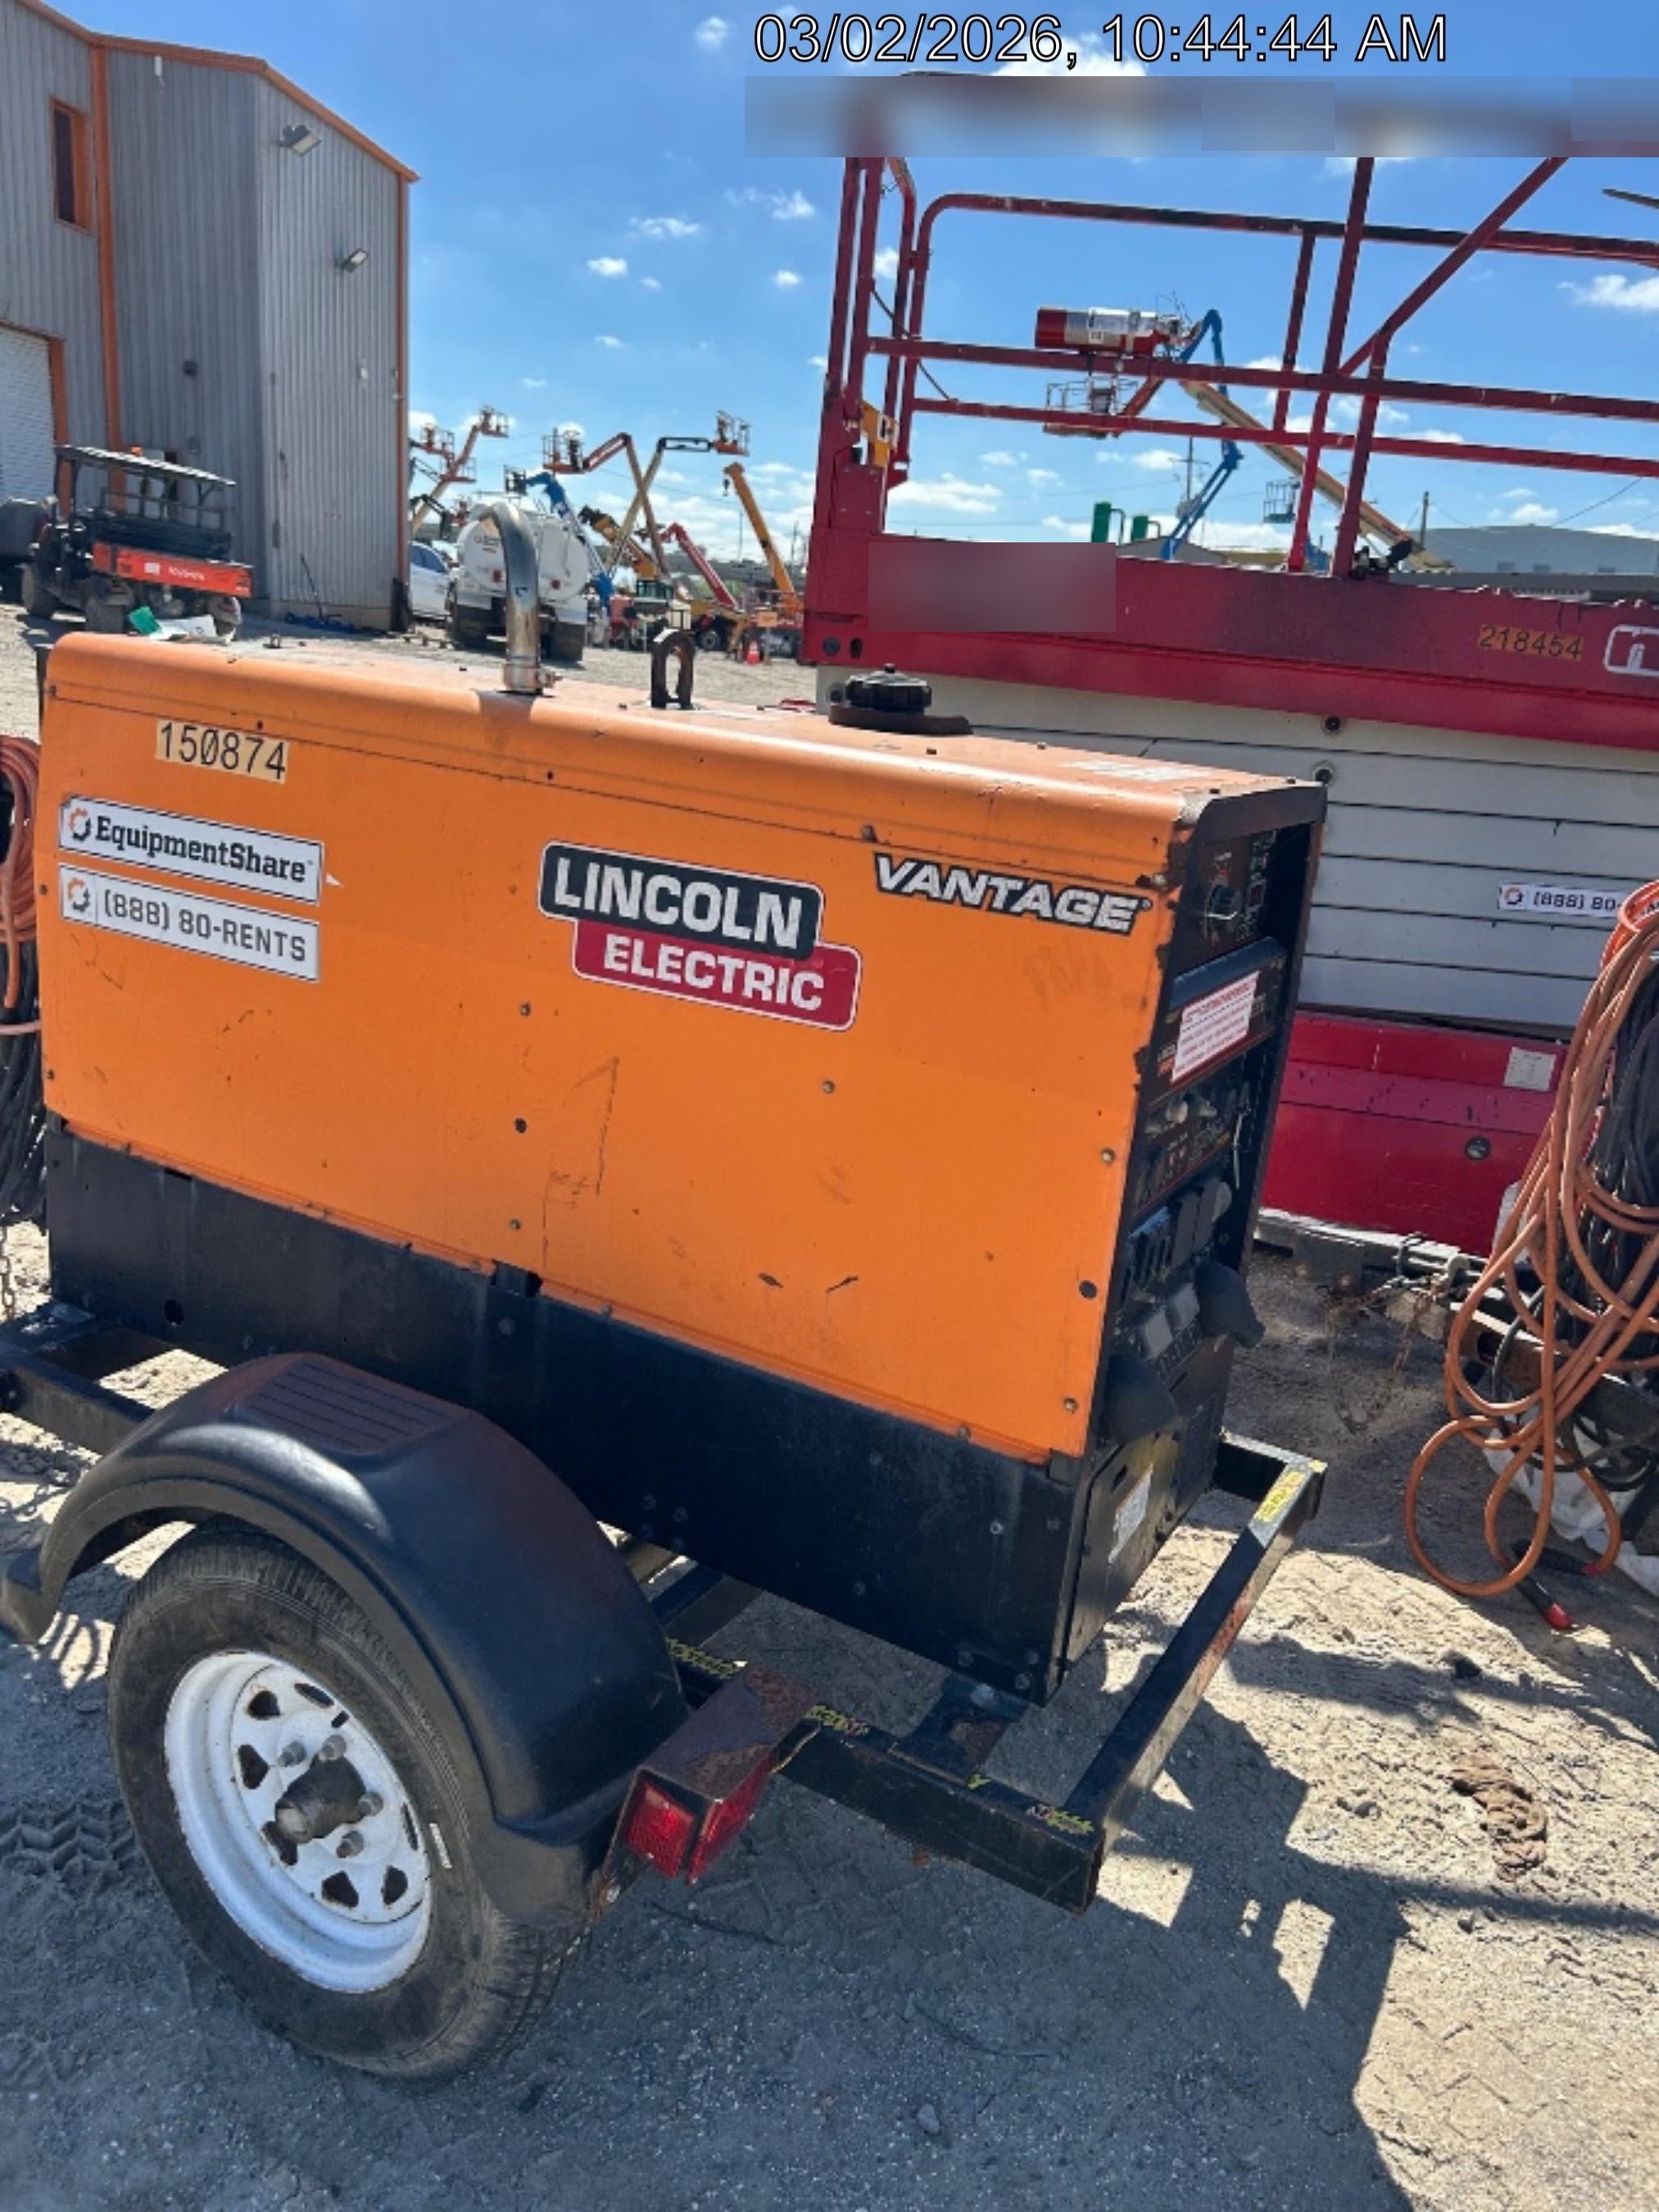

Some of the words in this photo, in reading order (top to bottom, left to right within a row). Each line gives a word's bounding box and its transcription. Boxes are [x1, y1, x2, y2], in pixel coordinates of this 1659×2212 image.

[1479, 625, 1582, 660] 218454
[161, 722, 286, 780] 150874
[95, 815, 306, 882] EquipmentShare
[103, 889, 170, 931] (888)
[178, 909, 306, 963] 80-RENTS
[554, 857, 802, 950] LINCOLN
[1533, 891, 1584, 910] (888)
[603, 933, 824, 1011] ELECTRIC
